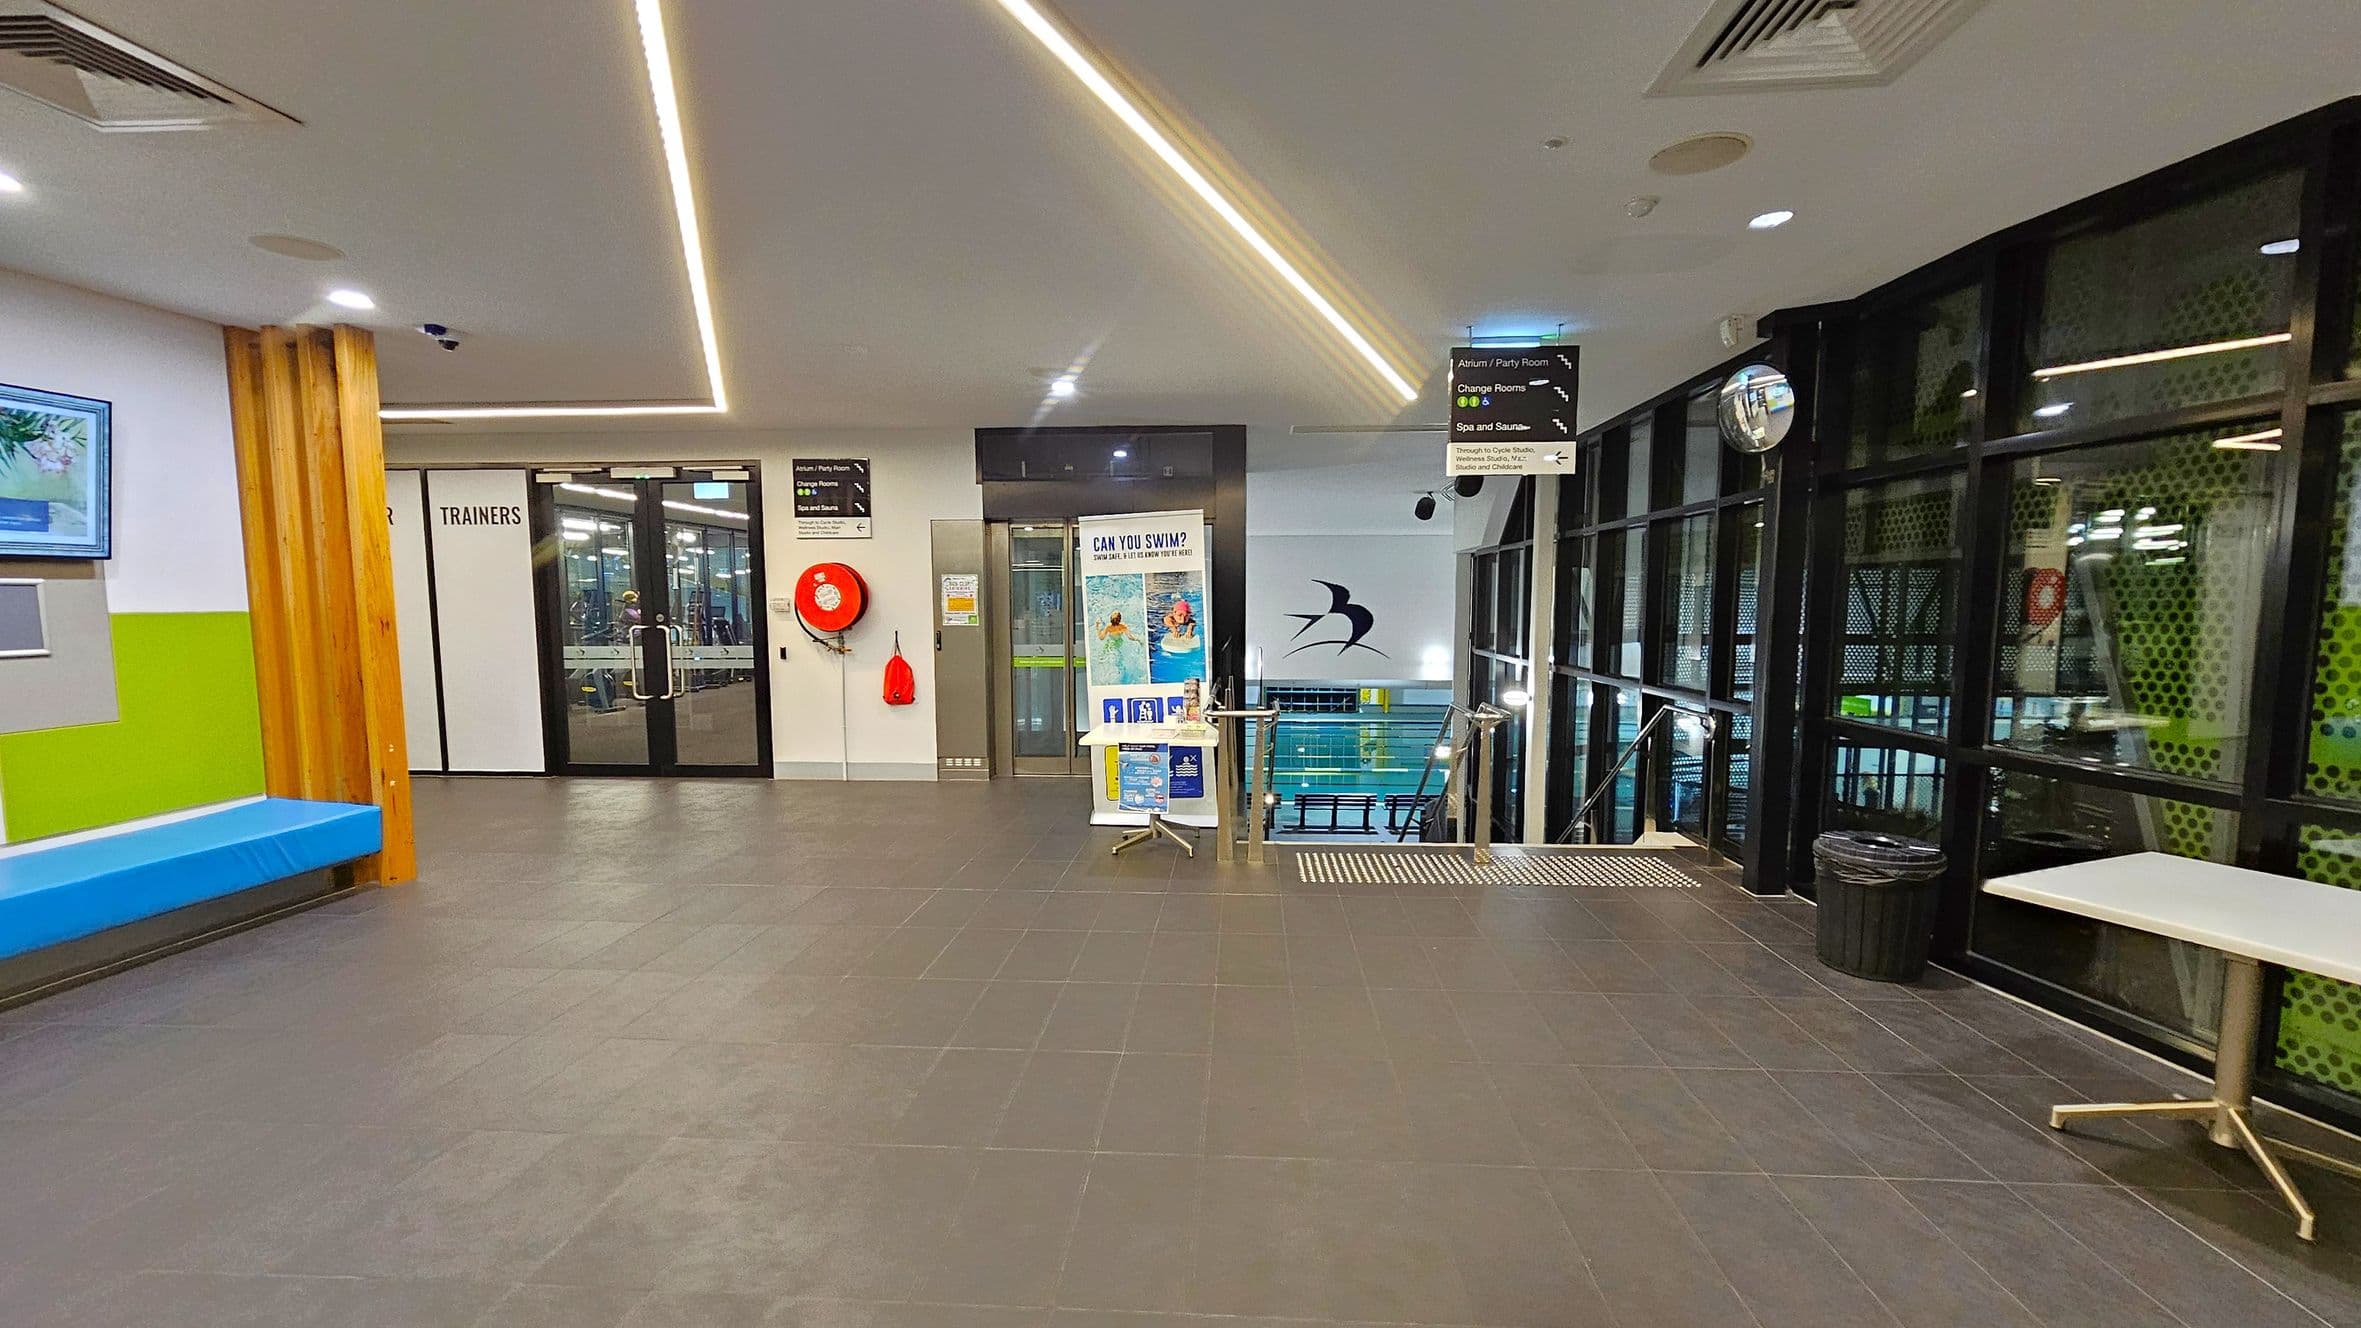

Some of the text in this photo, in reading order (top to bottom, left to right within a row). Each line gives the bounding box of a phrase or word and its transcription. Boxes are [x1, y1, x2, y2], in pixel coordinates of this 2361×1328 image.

[1458, 358, 1488, 368] Atrium
[1496, 358, 1520, 369] Party
[1522, 358, 1549, 366] Room
[1458, 384, 1526, 394] Change Rooms
[1456, 422, 1474, 433] Spa
[1476, 422, 1494, 432] and
[440, 506, 521, 525] TRAINERS
[1093, 532, 1187, 552] CAN YOU SWIM?
